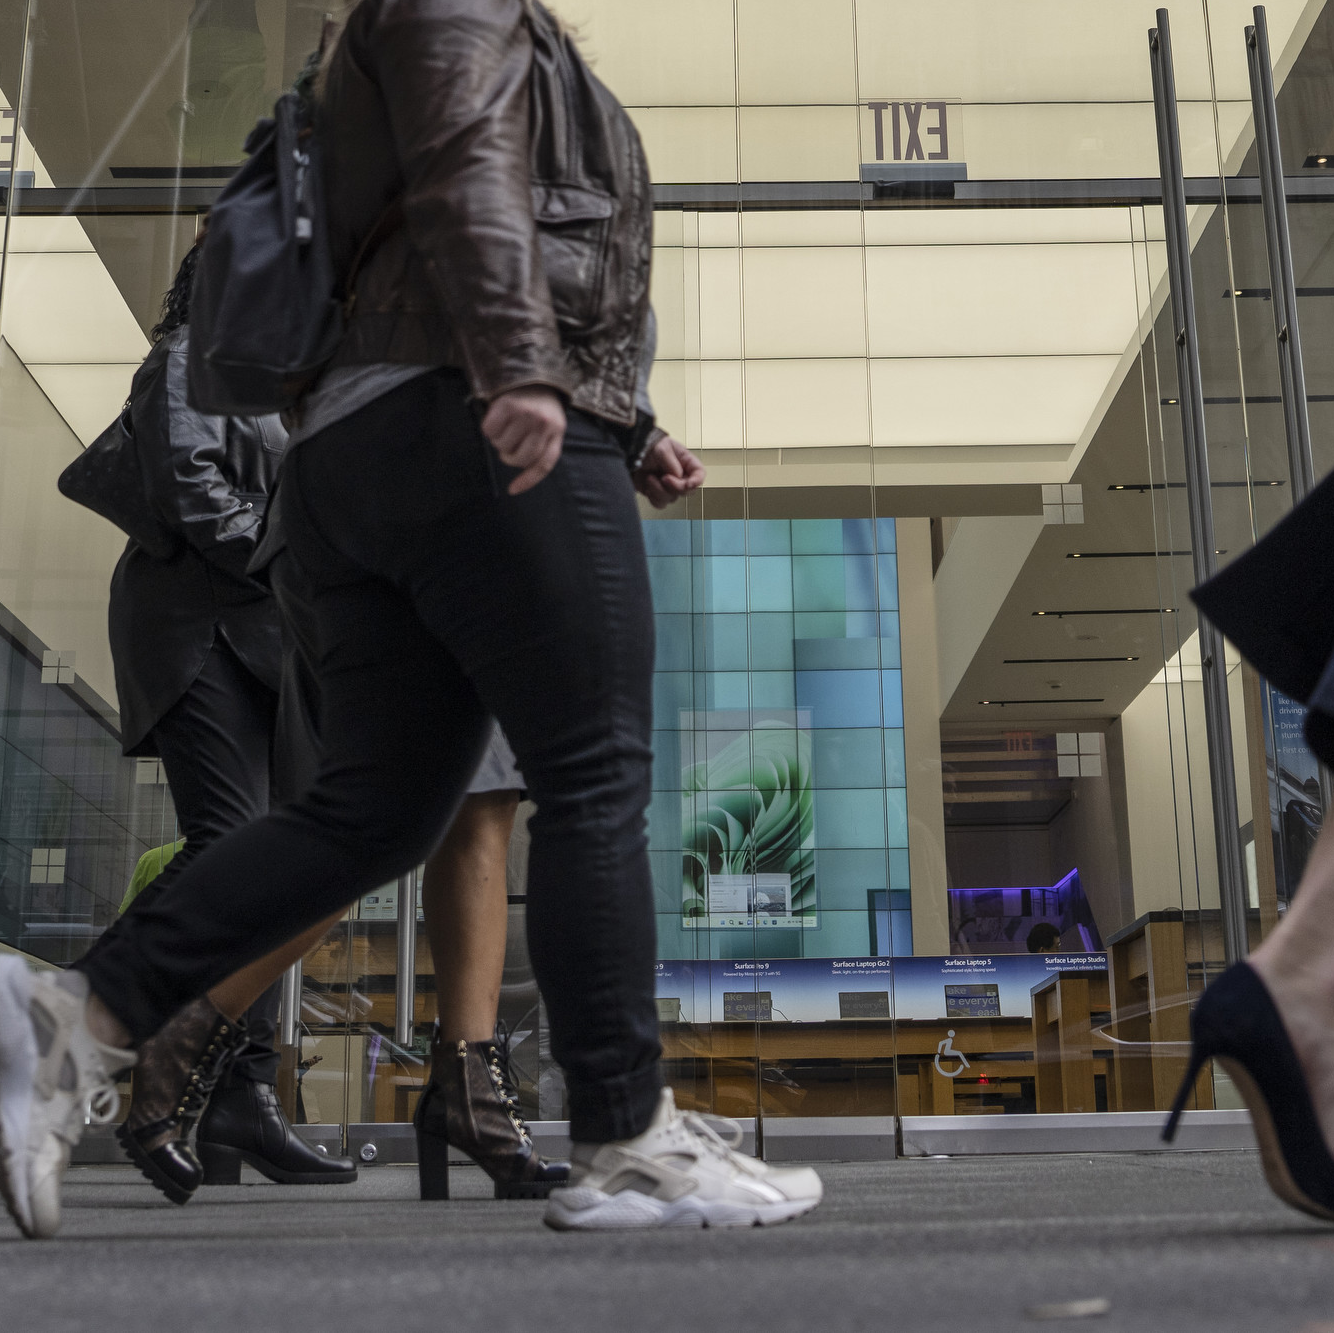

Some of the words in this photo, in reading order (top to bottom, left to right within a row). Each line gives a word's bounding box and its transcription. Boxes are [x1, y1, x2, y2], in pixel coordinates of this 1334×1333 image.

[856, 961, 877, 969] Laptop
[966, 959, 987, 967] Laptop
[1067, 957, 1087, 965] Laptop
